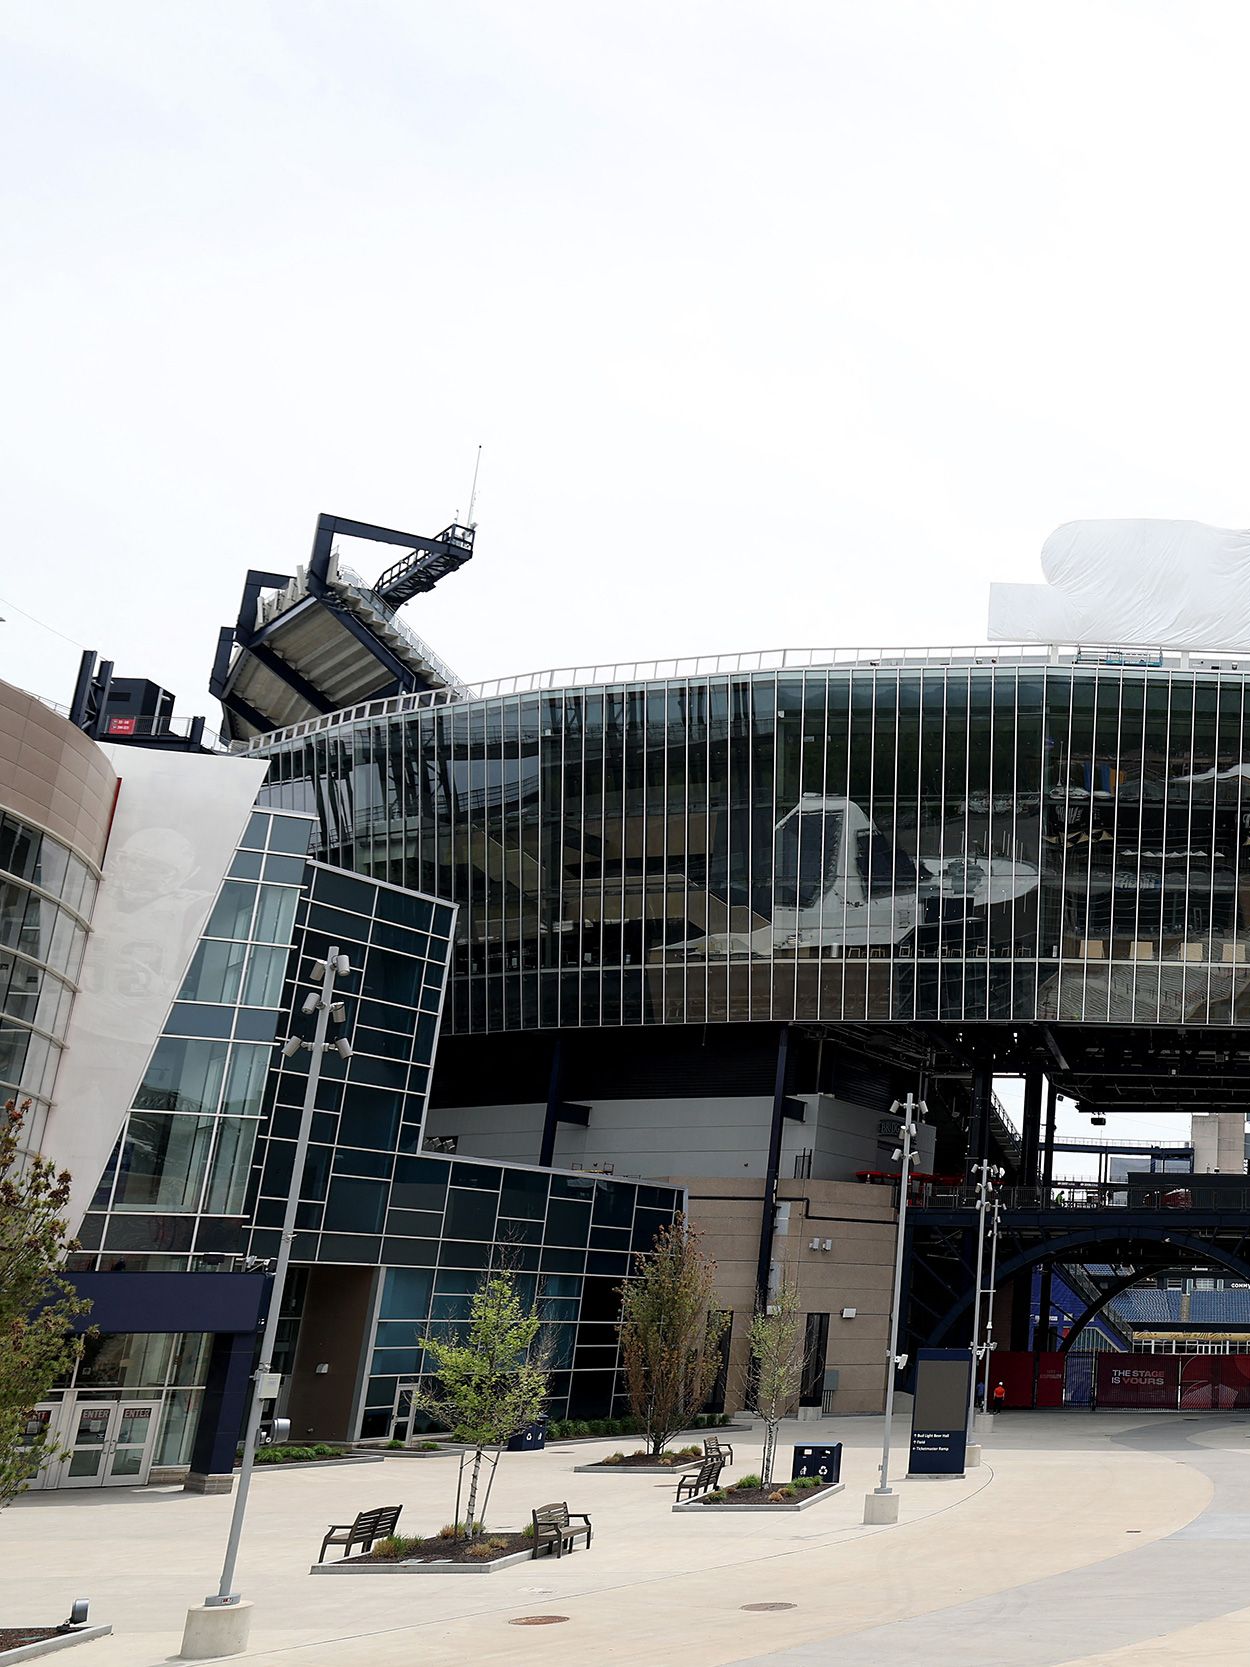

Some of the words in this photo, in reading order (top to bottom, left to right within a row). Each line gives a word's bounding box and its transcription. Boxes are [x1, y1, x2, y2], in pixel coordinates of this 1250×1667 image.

[1112, 1369, 1131, 1377] THE
[1133, 1370, 1165, 1378] STAGE
[1111, 1376, 1121, 1384] IS
[1123, 1377, 1165, 1385] YOURS
[82, 1410, 110, 1419] ENTER
[124, 1409, 151, 1418] ENTER
